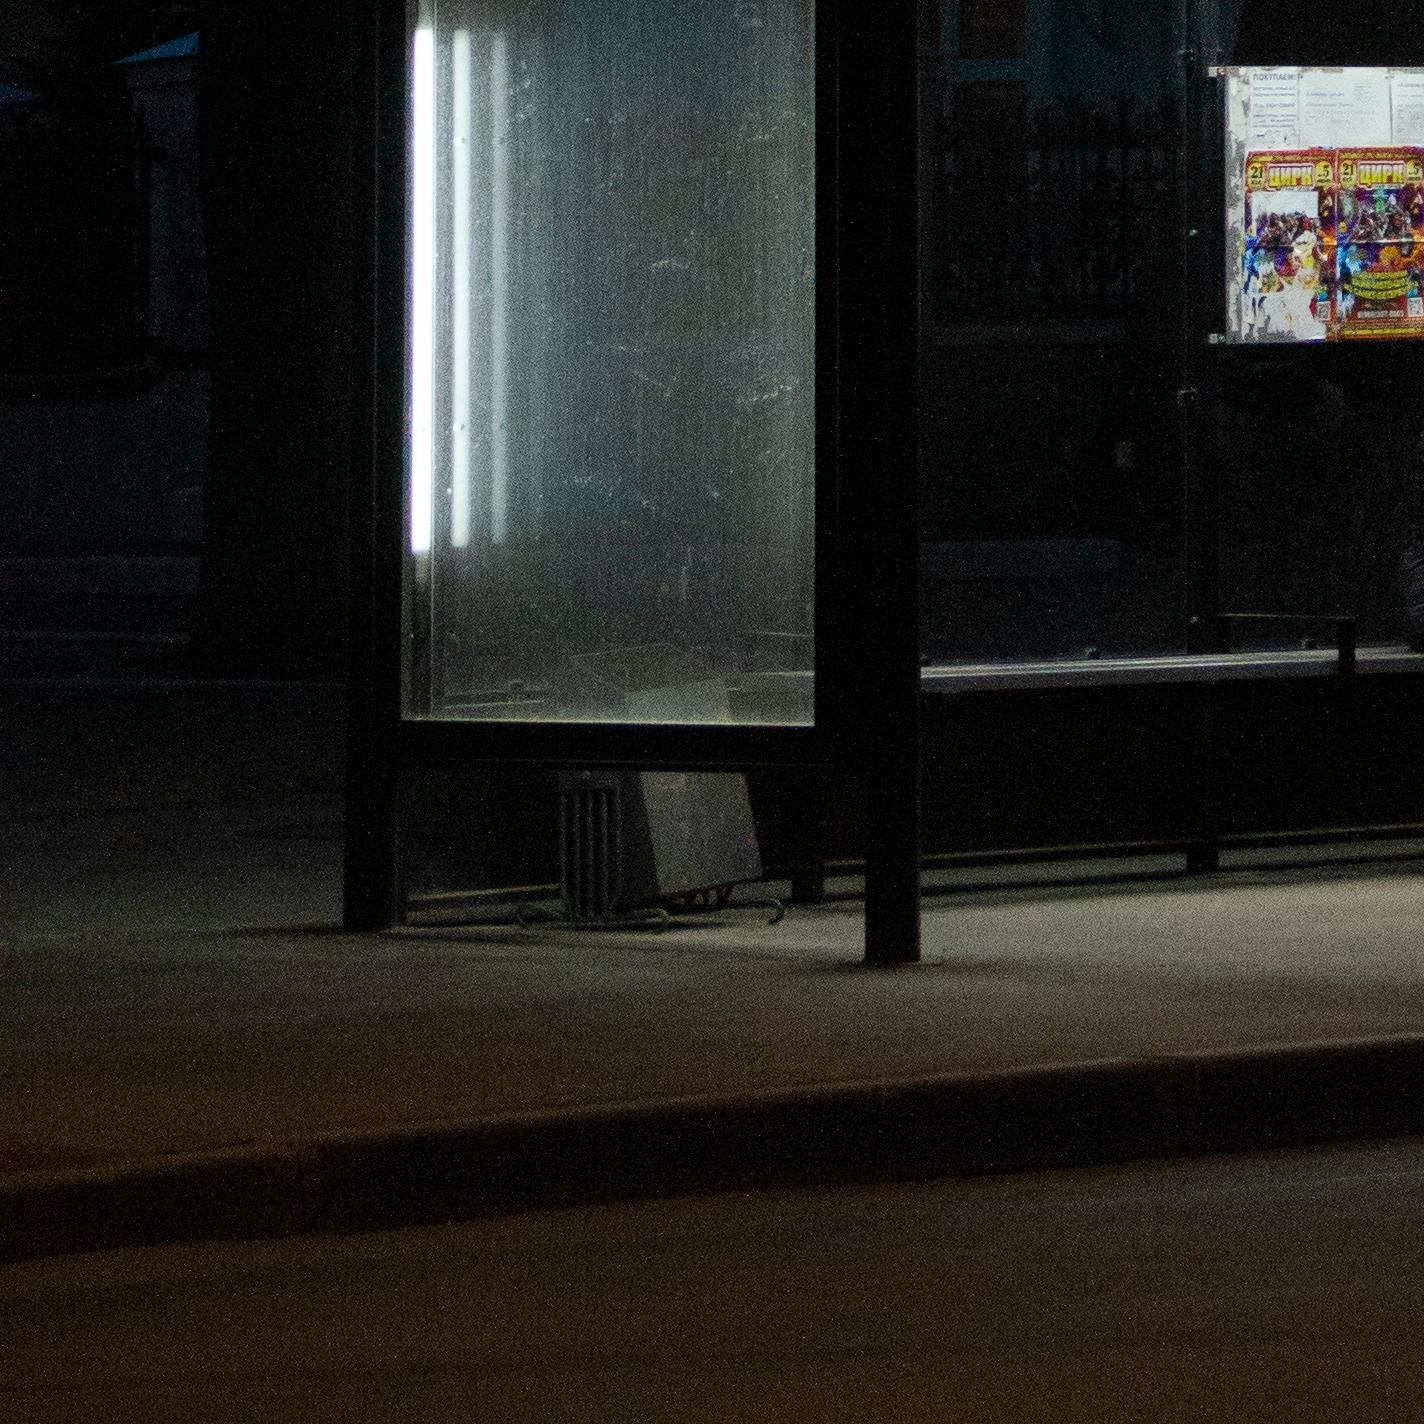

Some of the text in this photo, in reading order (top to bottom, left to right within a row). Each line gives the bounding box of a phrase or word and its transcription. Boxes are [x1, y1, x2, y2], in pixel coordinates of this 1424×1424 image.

[1250, 165, 1264, 179] 21
[1342, 163, 1355, 176] 21
[1359, 164, 1405, 187] ЦИРК
